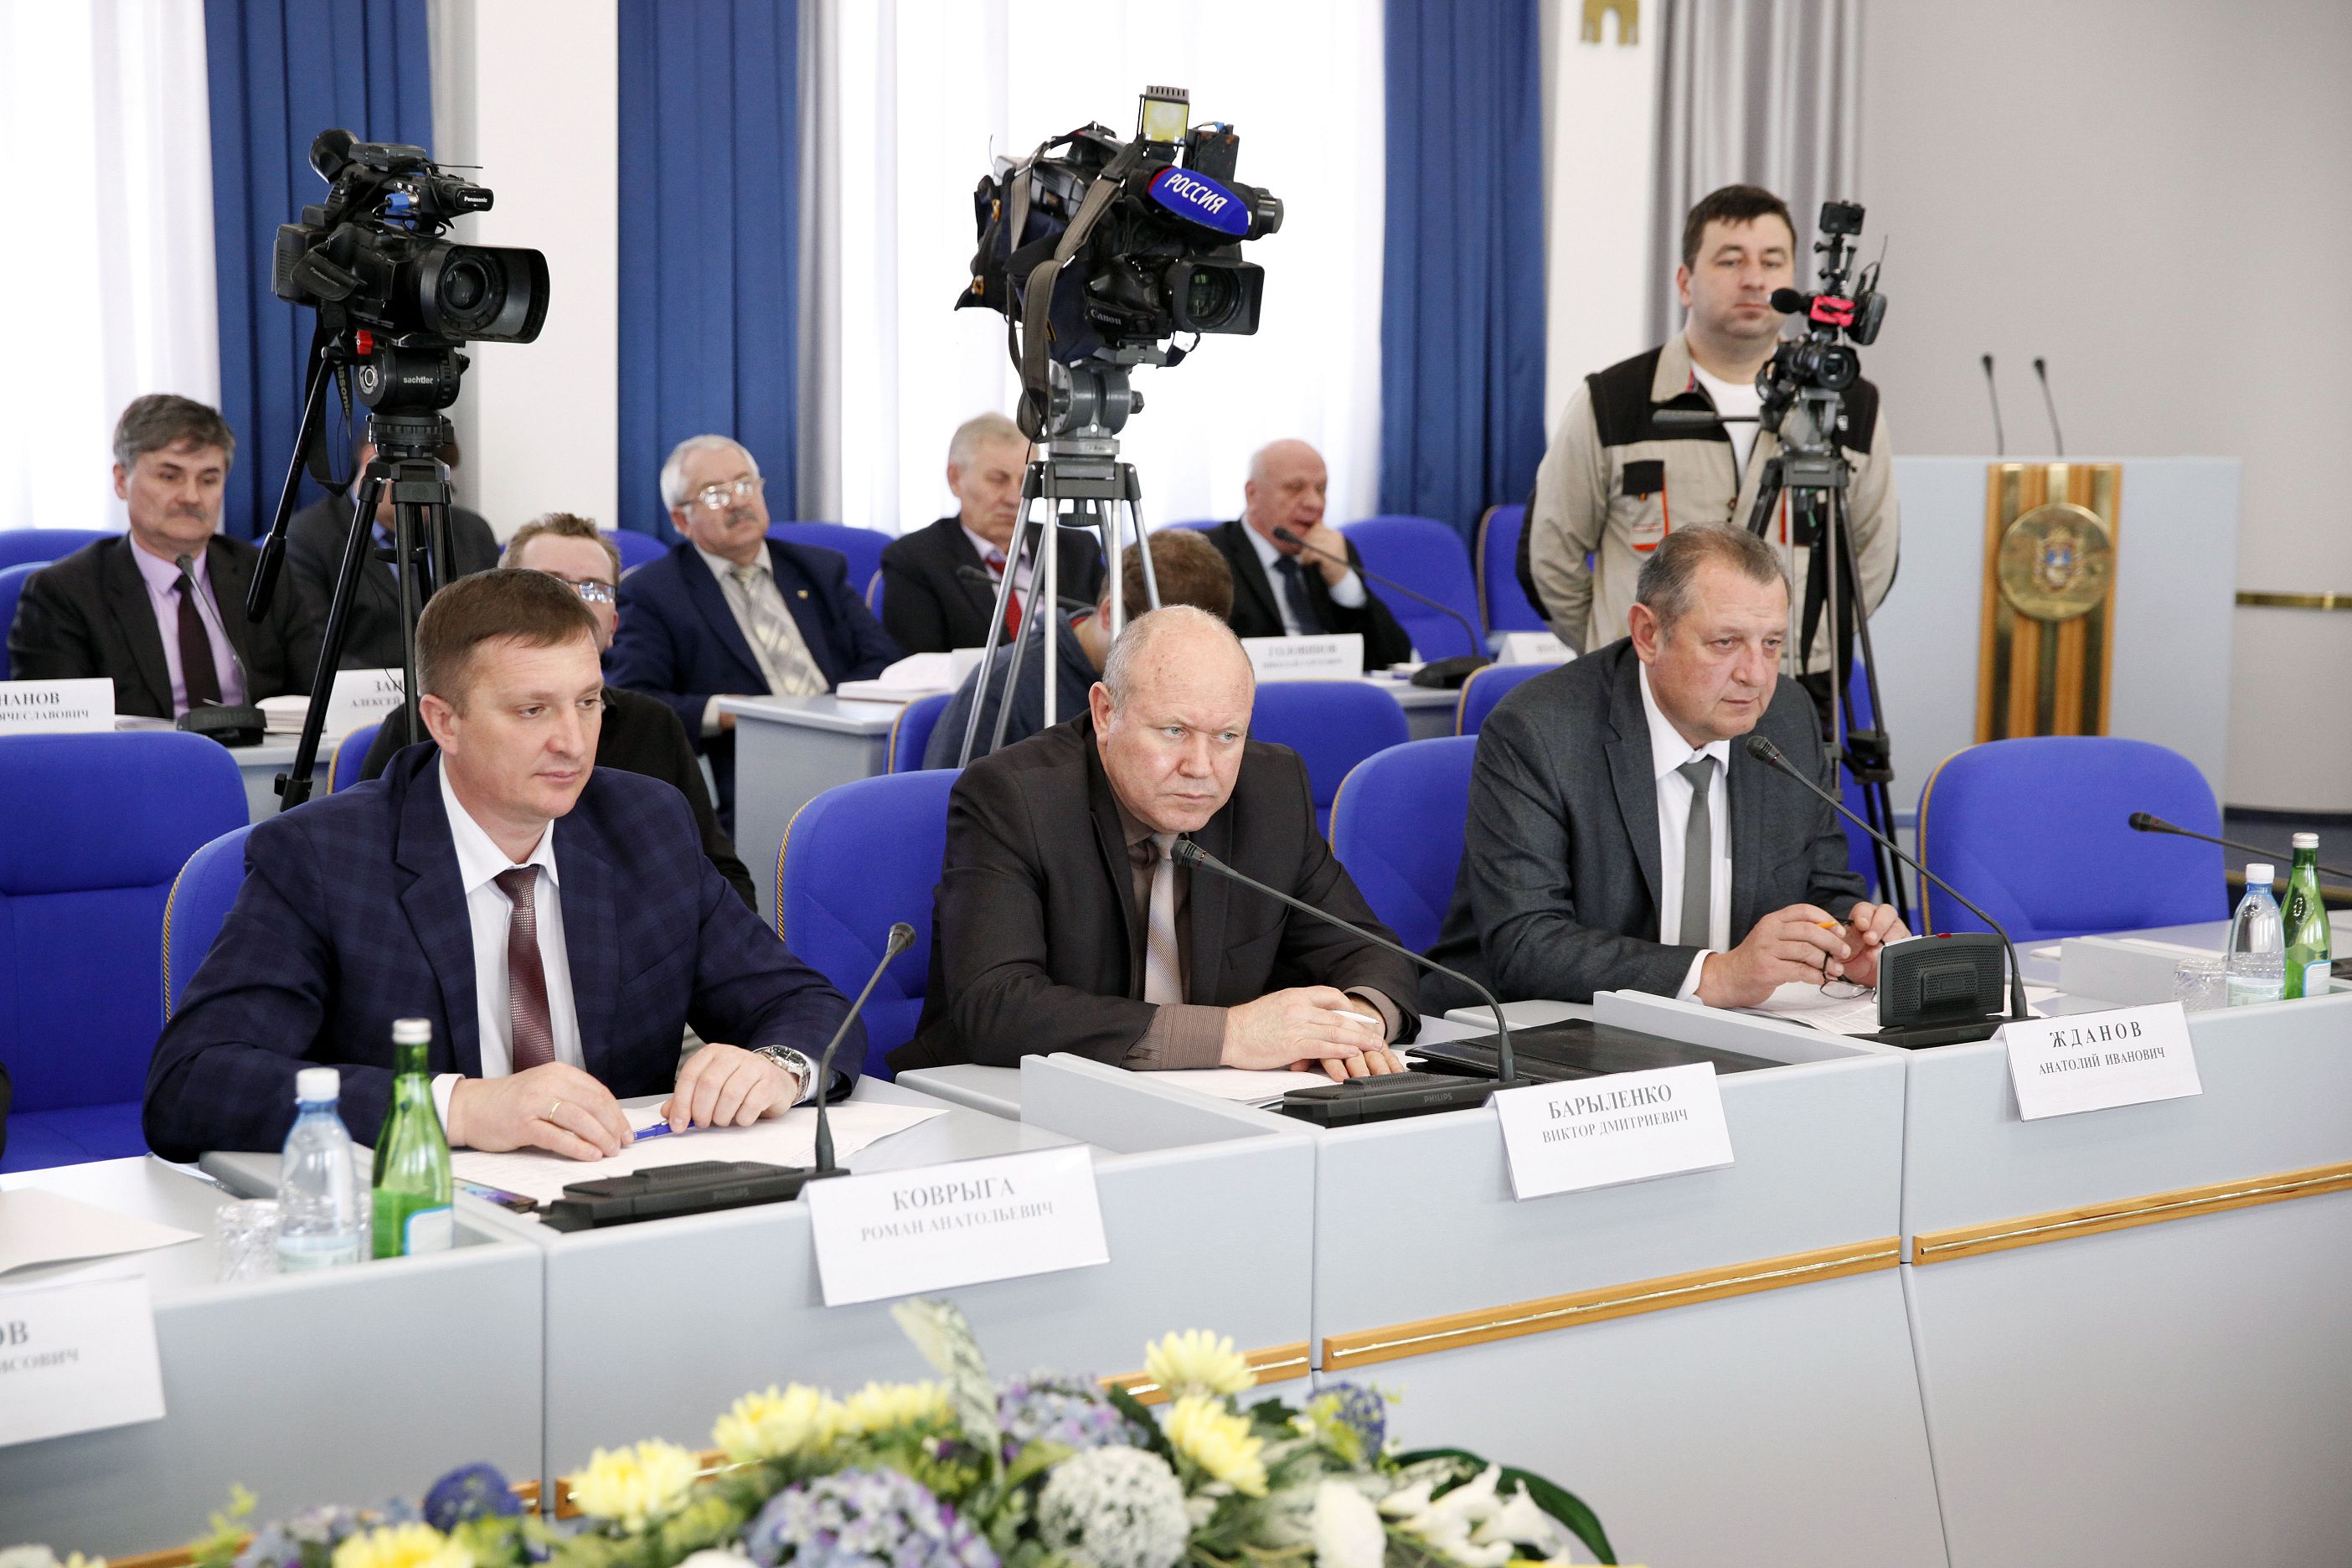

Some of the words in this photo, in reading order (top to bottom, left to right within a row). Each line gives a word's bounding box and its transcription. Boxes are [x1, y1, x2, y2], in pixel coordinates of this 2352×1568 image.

[1164, 173, 1228, 214] РОССИЯ
[1091, 309, 1122, 325] Canon
[403, 376, 434, 384] sachtler
[2049, 1021, 2143, 1050] ЖДАНОВ
[2038, 1053, 2102, 1075] АНАТОЛИЙ
[2105, 1047, 2166, 1066] ИВАНОВИЧ
[1424, 1092, 1452, 1104] PHILIPS
[1548, 1084, 1673, 1120] БАРЫЛЕНКО
[1542, 1123, 1596, 1144] ВИКТОР
[1600, 1109, 1689, 1137] ДМИТРИЕВИЧ
[892, 1177, 1015, 1211] КОВРЫГА
[861, 1222, 923, 1242] РОМАН
[929, 1201, 1055, 1232] АНАТОЛЬЕВИЧ
